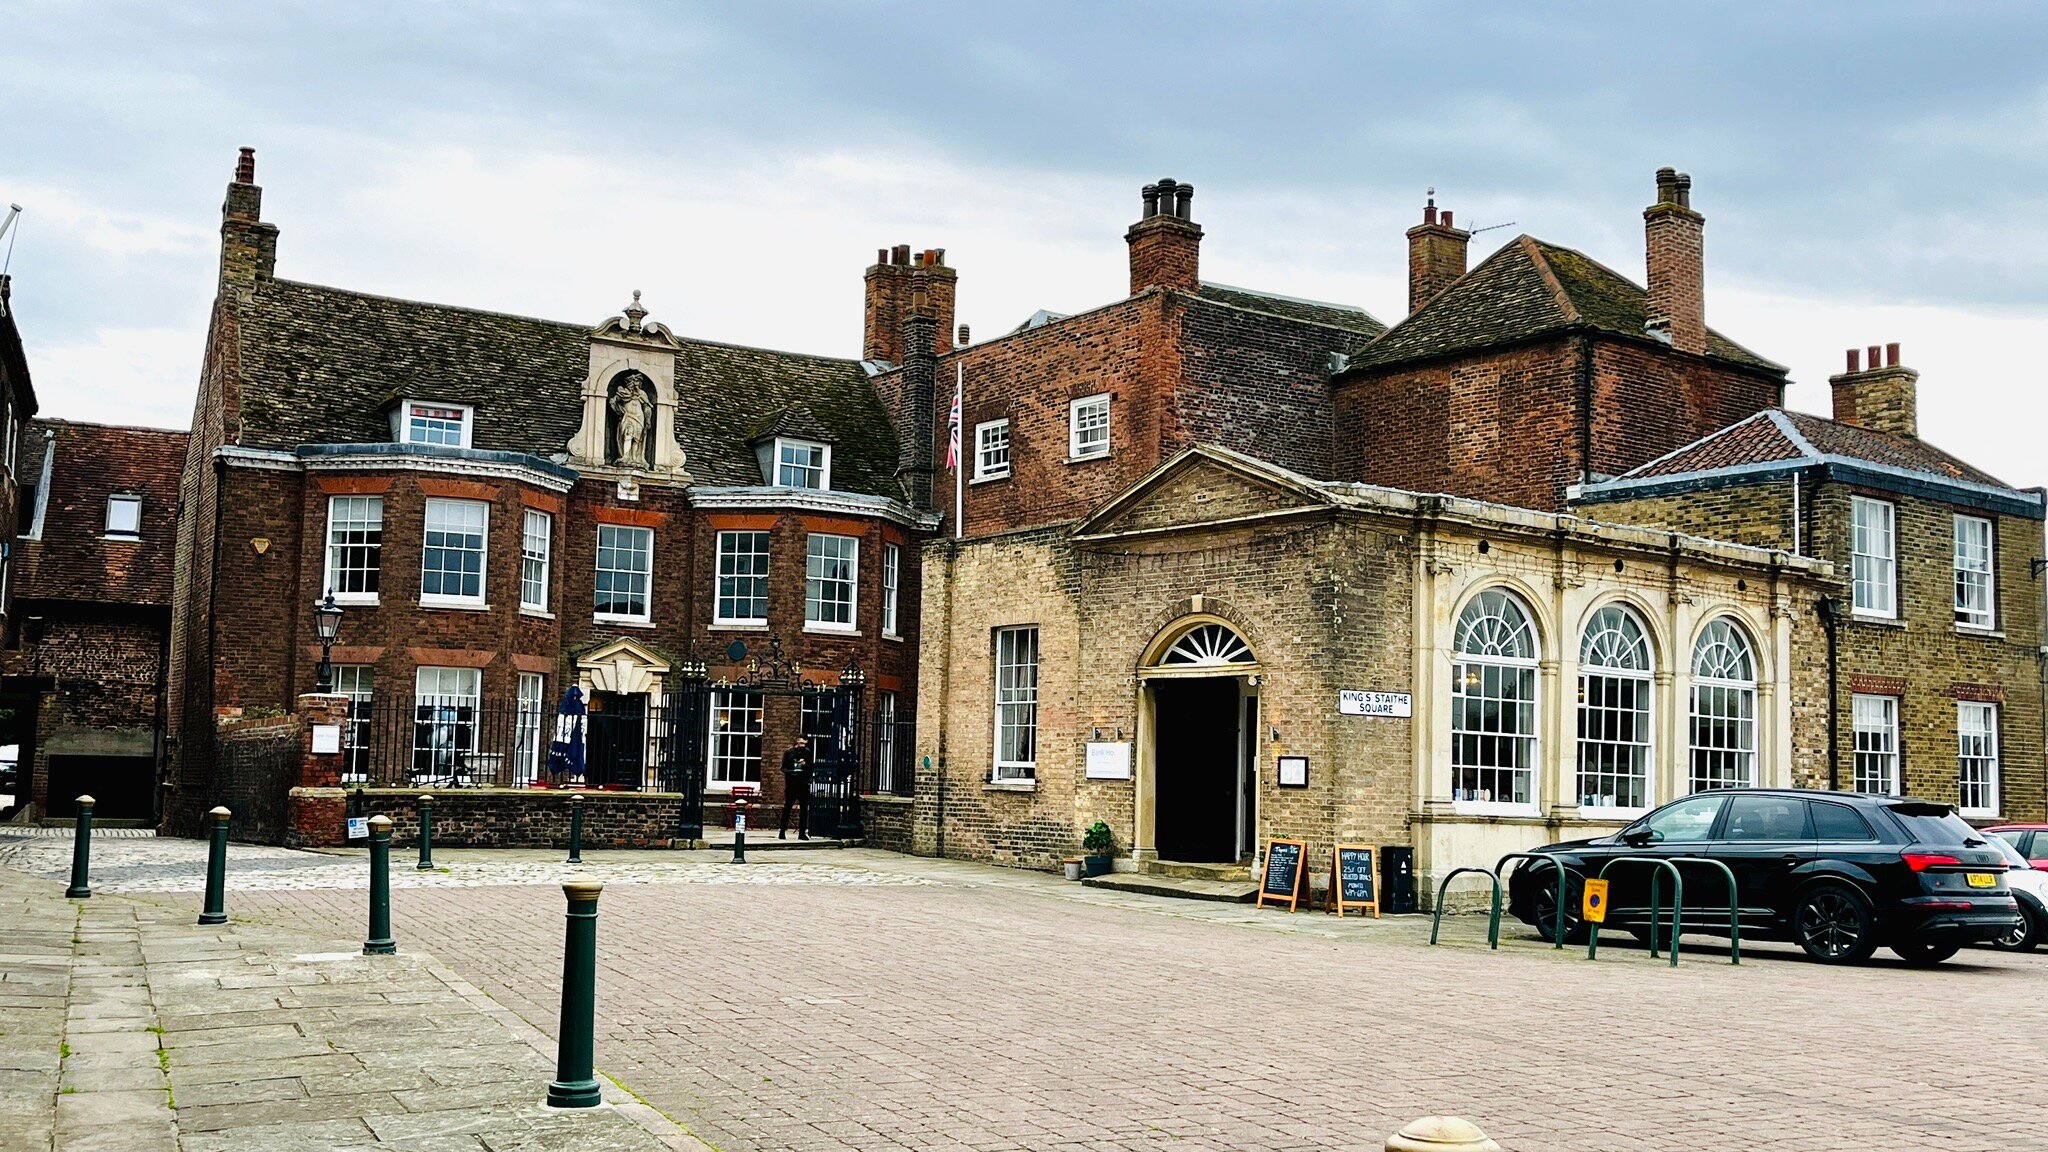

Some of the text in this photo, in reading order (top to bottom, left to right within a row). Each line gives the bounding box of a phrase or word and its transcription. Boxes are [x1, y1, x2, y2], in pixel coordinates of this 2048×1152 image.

[1375, 694, 1408, 704] STAITHE
[1360, 703, 1393, 713] SQUARE
[1341, 851, 1370, 861] HAPPY HOUR
